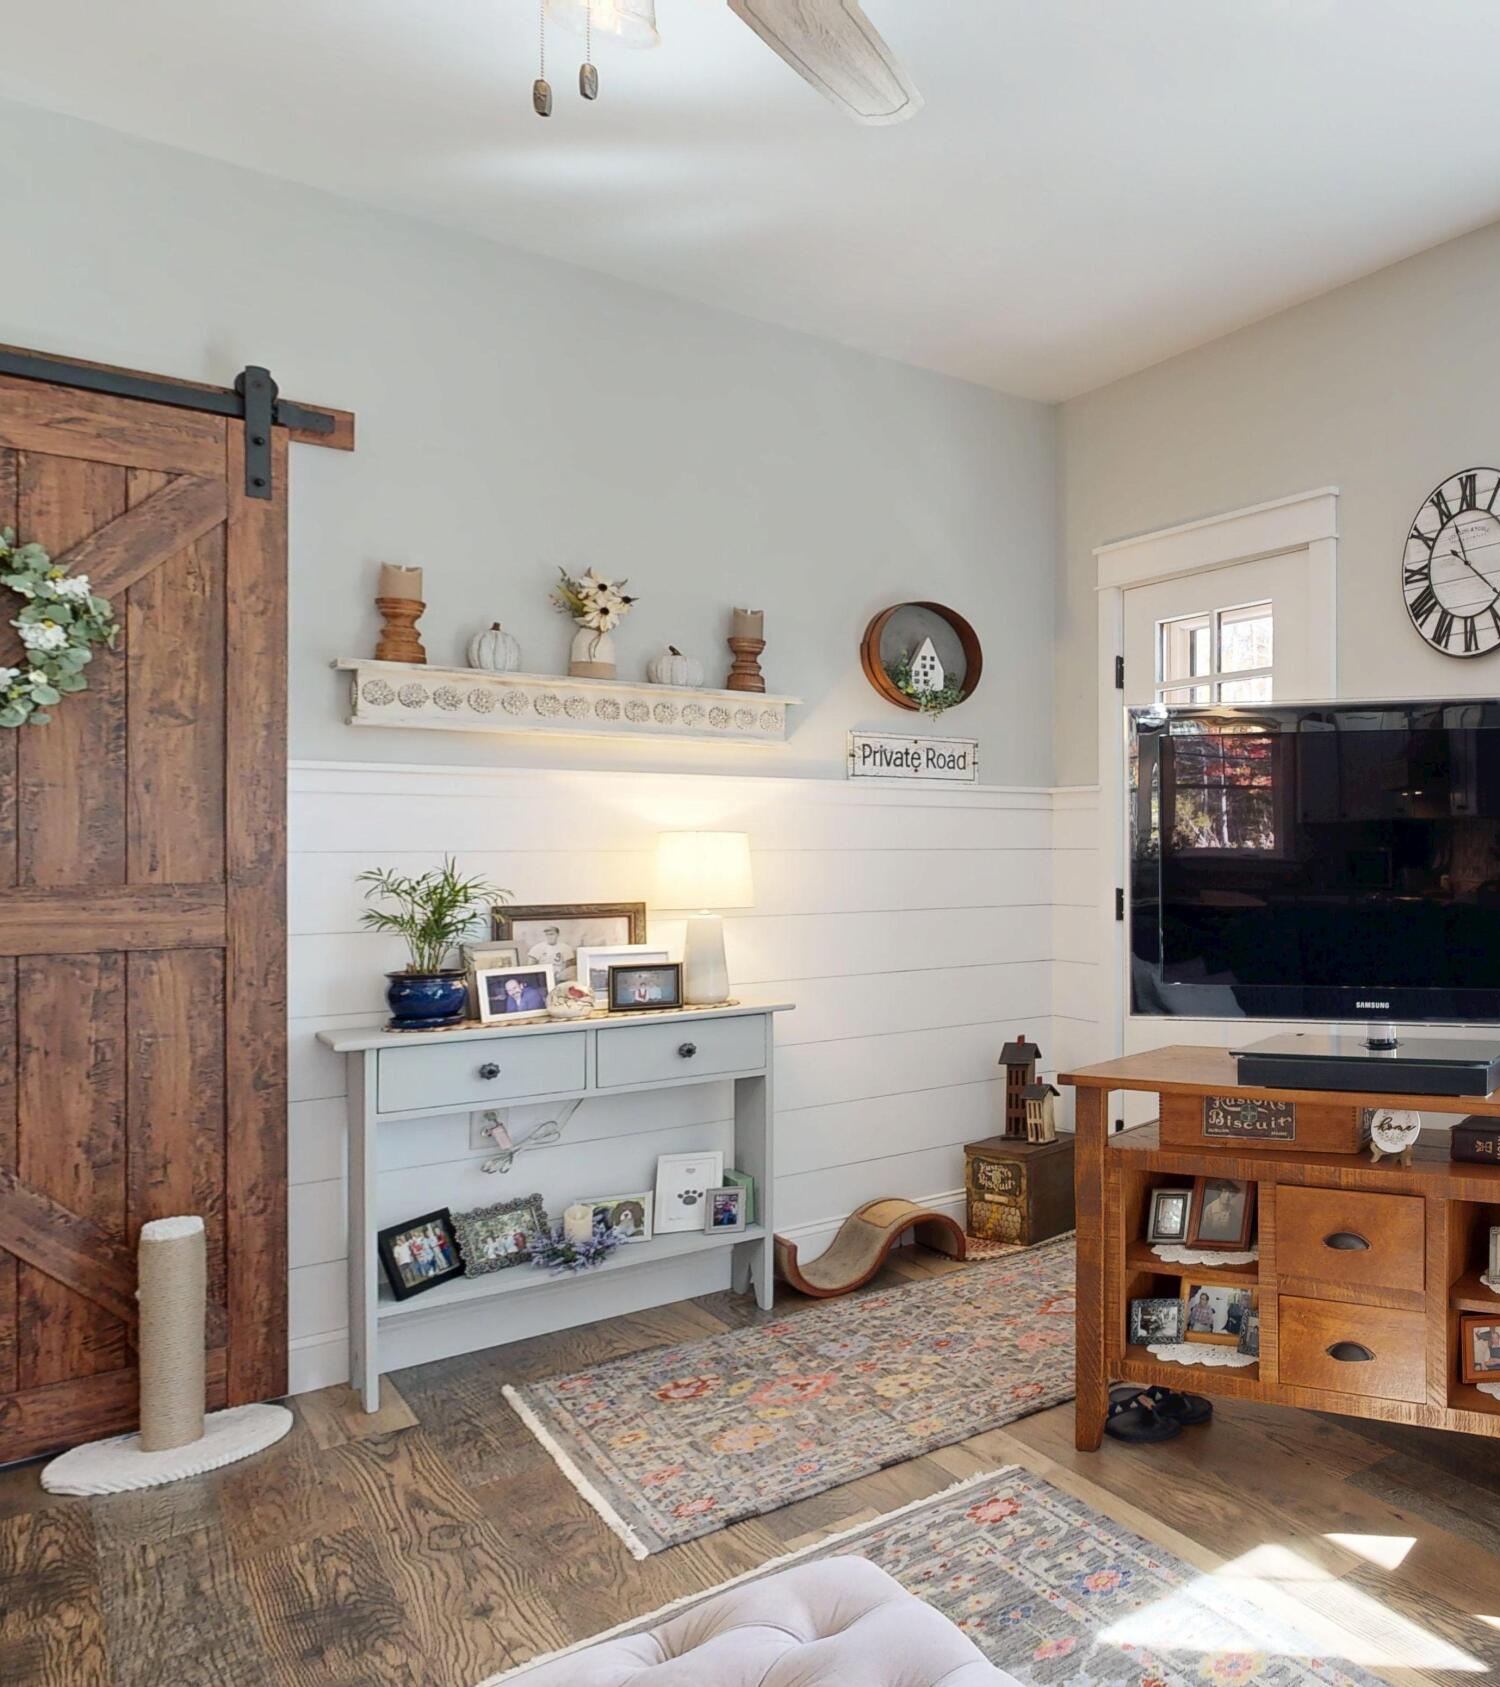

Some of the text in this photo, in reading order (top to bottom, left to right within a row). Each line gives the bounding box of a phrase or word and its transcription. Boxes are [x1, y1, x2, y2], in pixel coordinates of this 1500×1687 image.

[1458, 474, 1477, 511] XII
[1430, 489, 1452, 527] XI
[1410, 524, 1435, 550] X
[862, 743, 967, 770] Private Road
[1355, 1001, 1390, 1009] SAMSUNG
[1207, 1108, 1292, 1130] Biscuit
[1373, 1116, 1417, 1132] home
